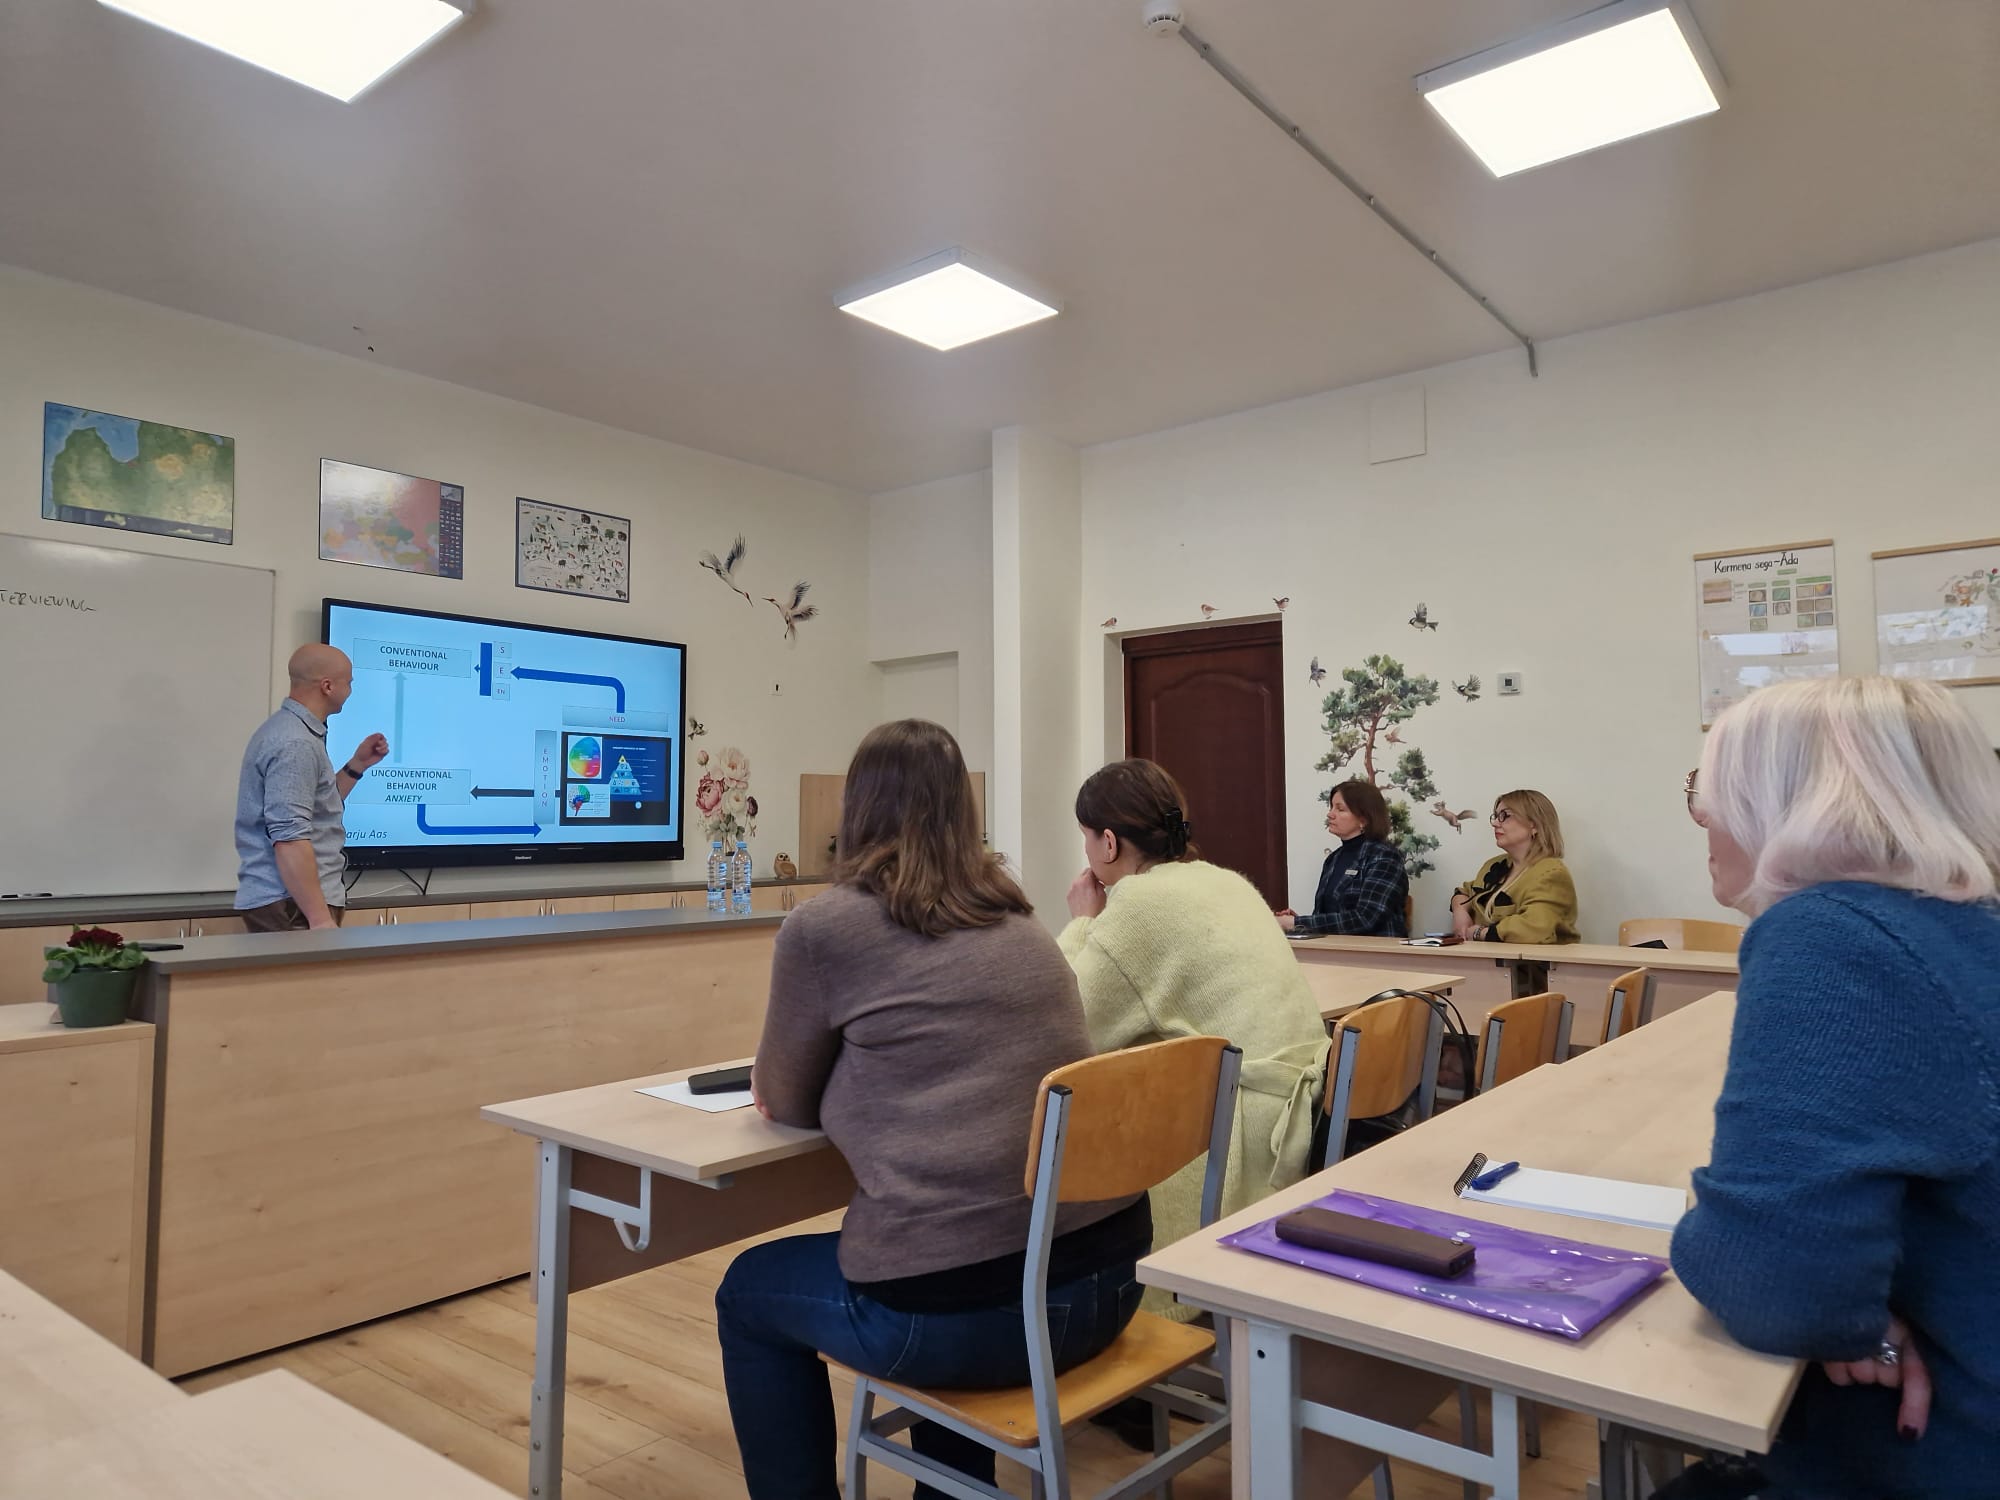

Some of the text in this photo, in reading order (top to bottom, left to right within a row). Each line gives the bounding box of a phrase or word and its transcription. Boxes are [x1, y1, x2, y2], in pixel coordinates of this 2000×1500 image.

[380, 645, 448, 660] CONVENTIONAL
[500, 646, 505, 654] S
[389, 659, 439, 671] BEHAVIOUR
[499, 667, 505, 675] E
[609, 715, 626, 723] NEED
[371, 769, 453, 779] UNCONVENTIONAL
[386, 782, 437, 791] BEHAVIOUR
[385, 794, 423, 803] ANXIETY
[345, 829, 387, 840] arju Aas
